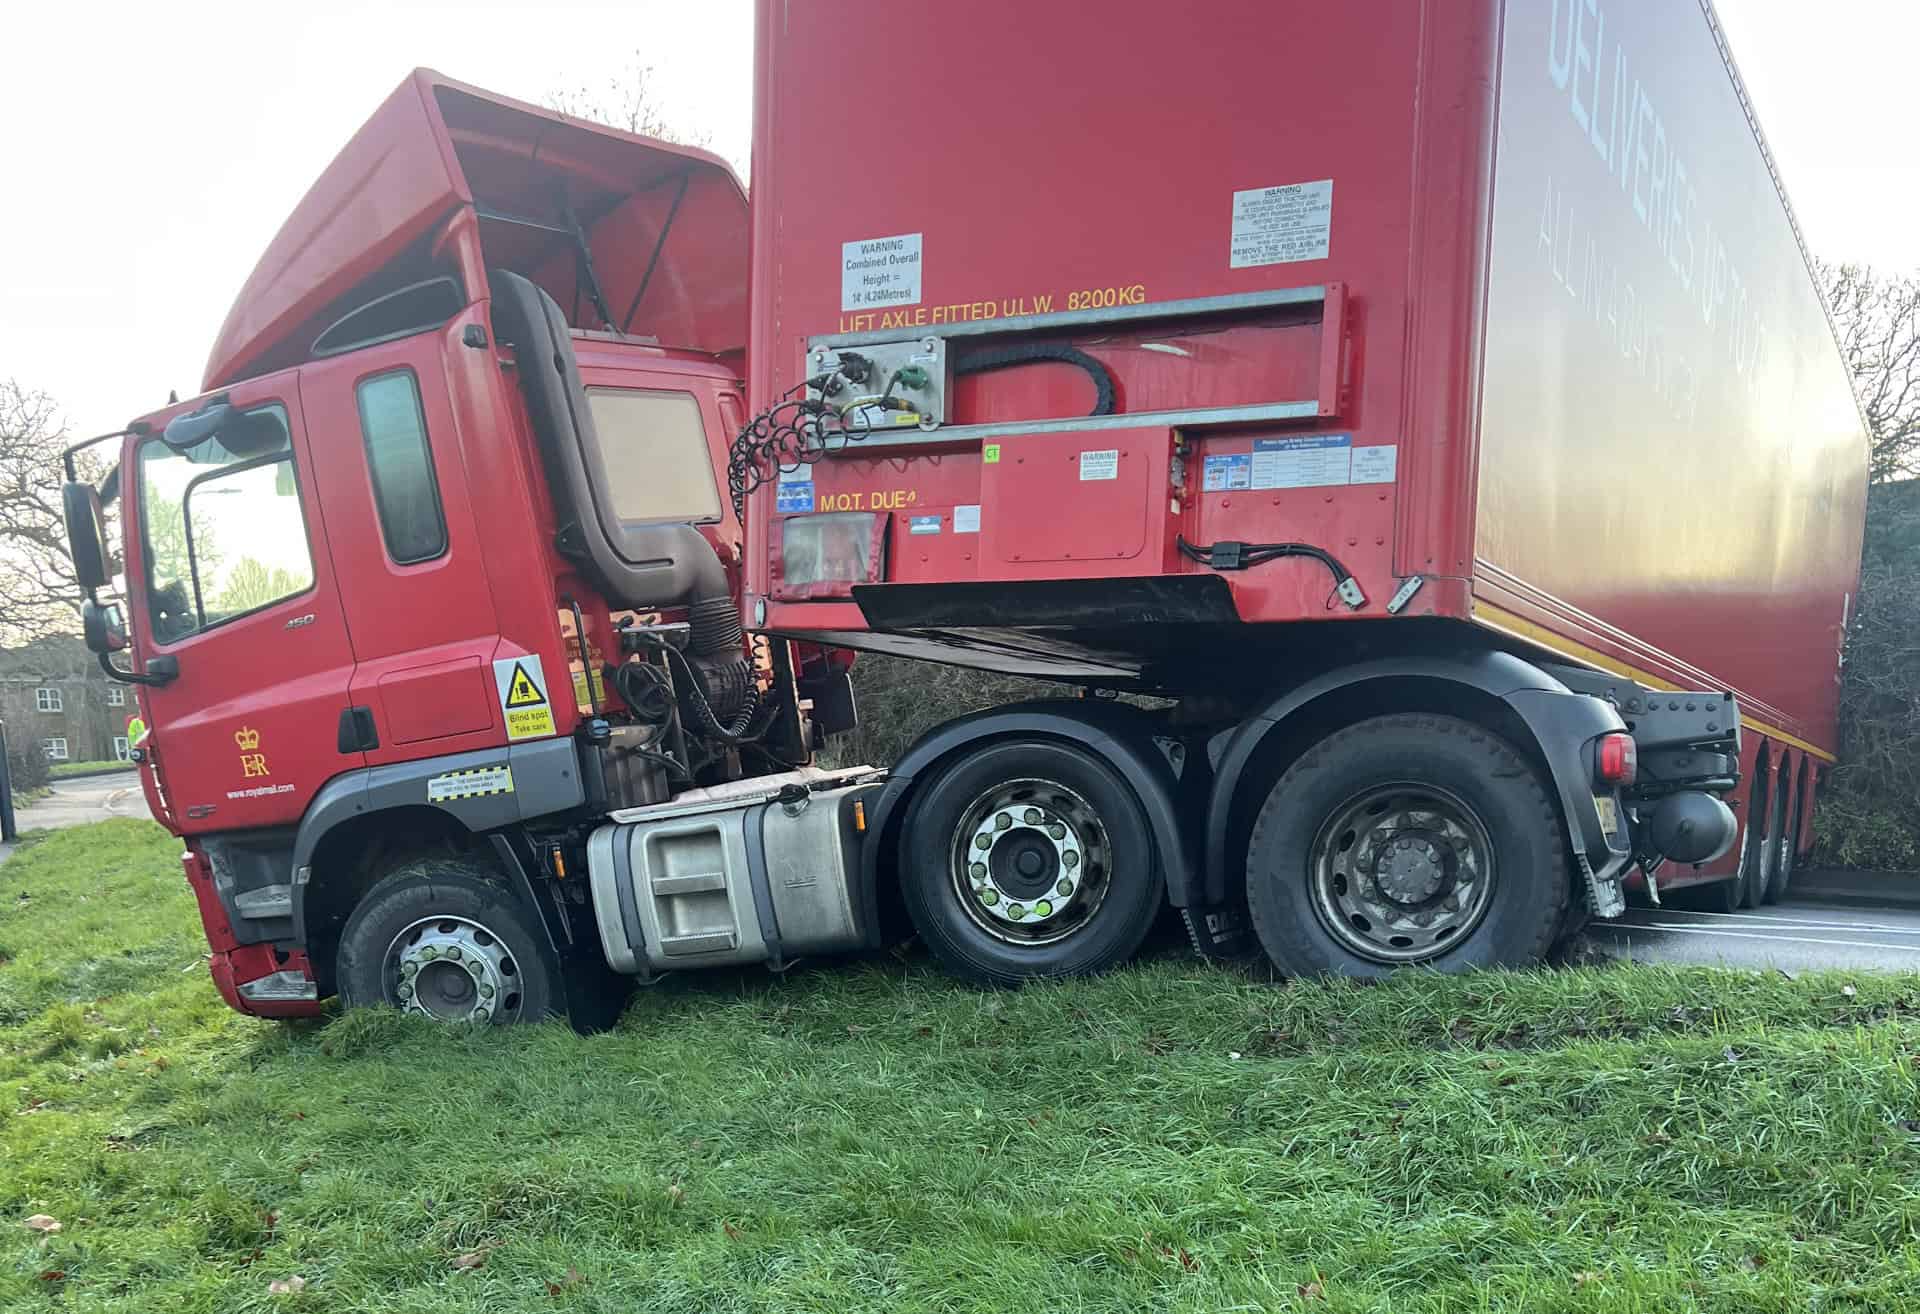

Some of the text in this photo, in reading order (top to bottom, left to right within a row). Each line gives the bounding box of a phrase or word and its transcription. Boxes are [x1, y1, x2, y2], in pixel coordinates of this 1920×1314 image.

[1537, 175, 1576, 297] ALL
[861, 240, 904, 254] WARNING
[846, 251, 919, 271] Combined Overall
[863, 273, 890, 286] Height
[1701, 221, 1728, 333] UP
[839, 284, 1145, 333] LIFT AXLE FITTED U.L.W. 8200 KG
[820, 492, 865, 512] M.O.T.
[509, 711, 549, 723] Blind spot
[515, 725, 531, 733] Take
[226, 783, 296, 800] www.royalmail.com
